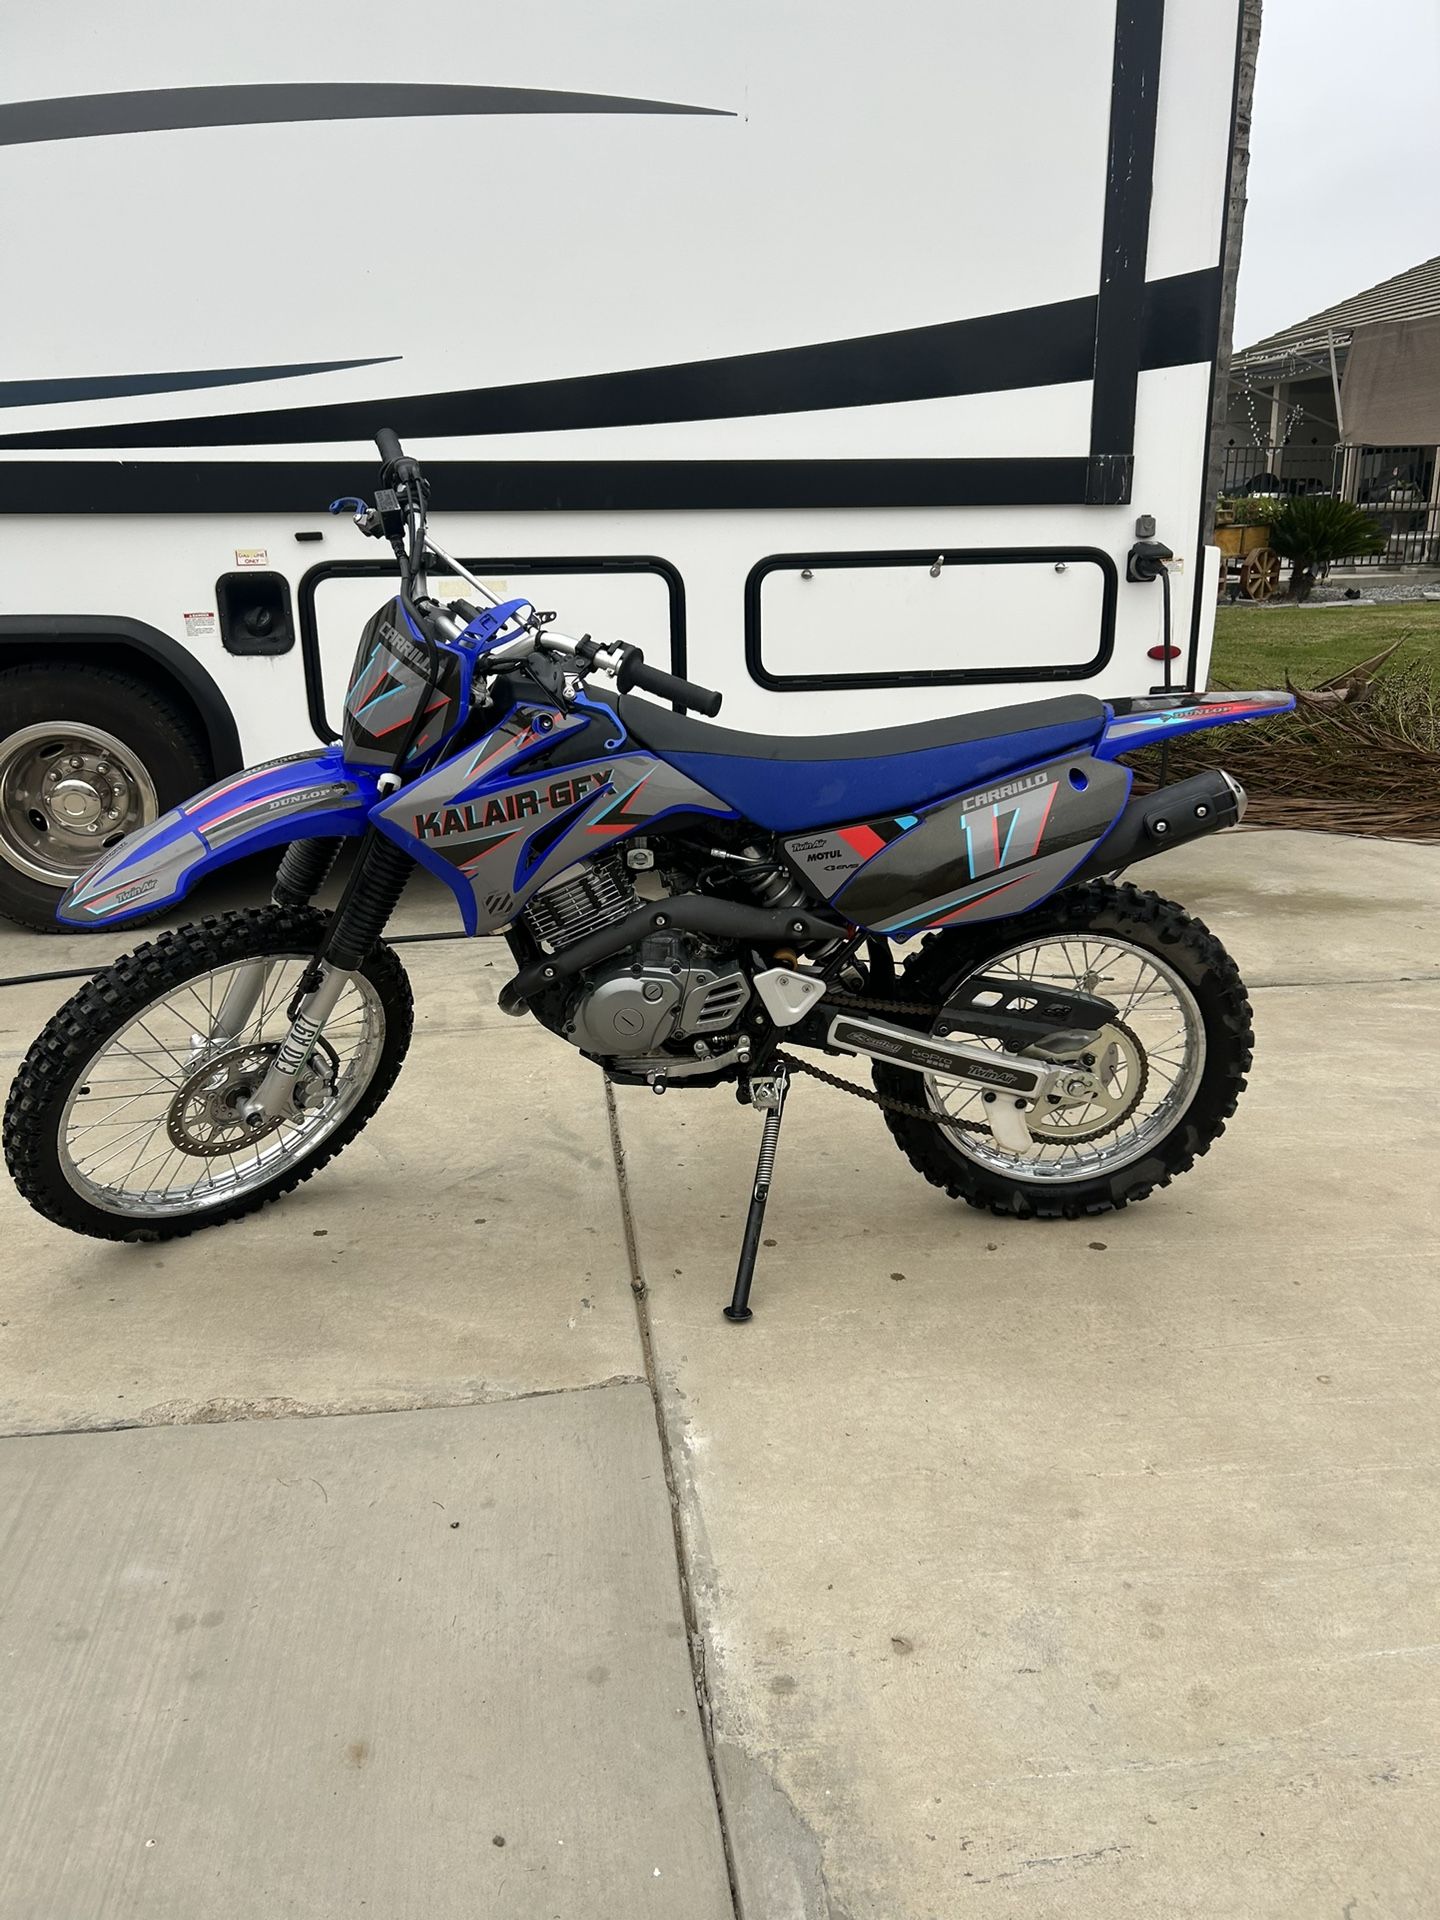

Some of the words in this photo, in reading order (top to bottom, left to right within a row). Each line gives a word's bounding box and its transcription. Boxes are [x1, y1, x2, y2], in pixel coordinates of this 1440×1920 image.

[1173, 706, 1233, 719] DUNLOP
[268, 789, 330, 810] DUNLOP
[413, 768, 619, 839] KALAIR-GFX
[962, 772, 1048, 812] CARRILLO
[961, 781, 1059, 880] 17
[807, 850, 842, 862] MOTUL
[290, 1014, 319, 1047] A97
[911, 1049, 953, 1065] GoPro
